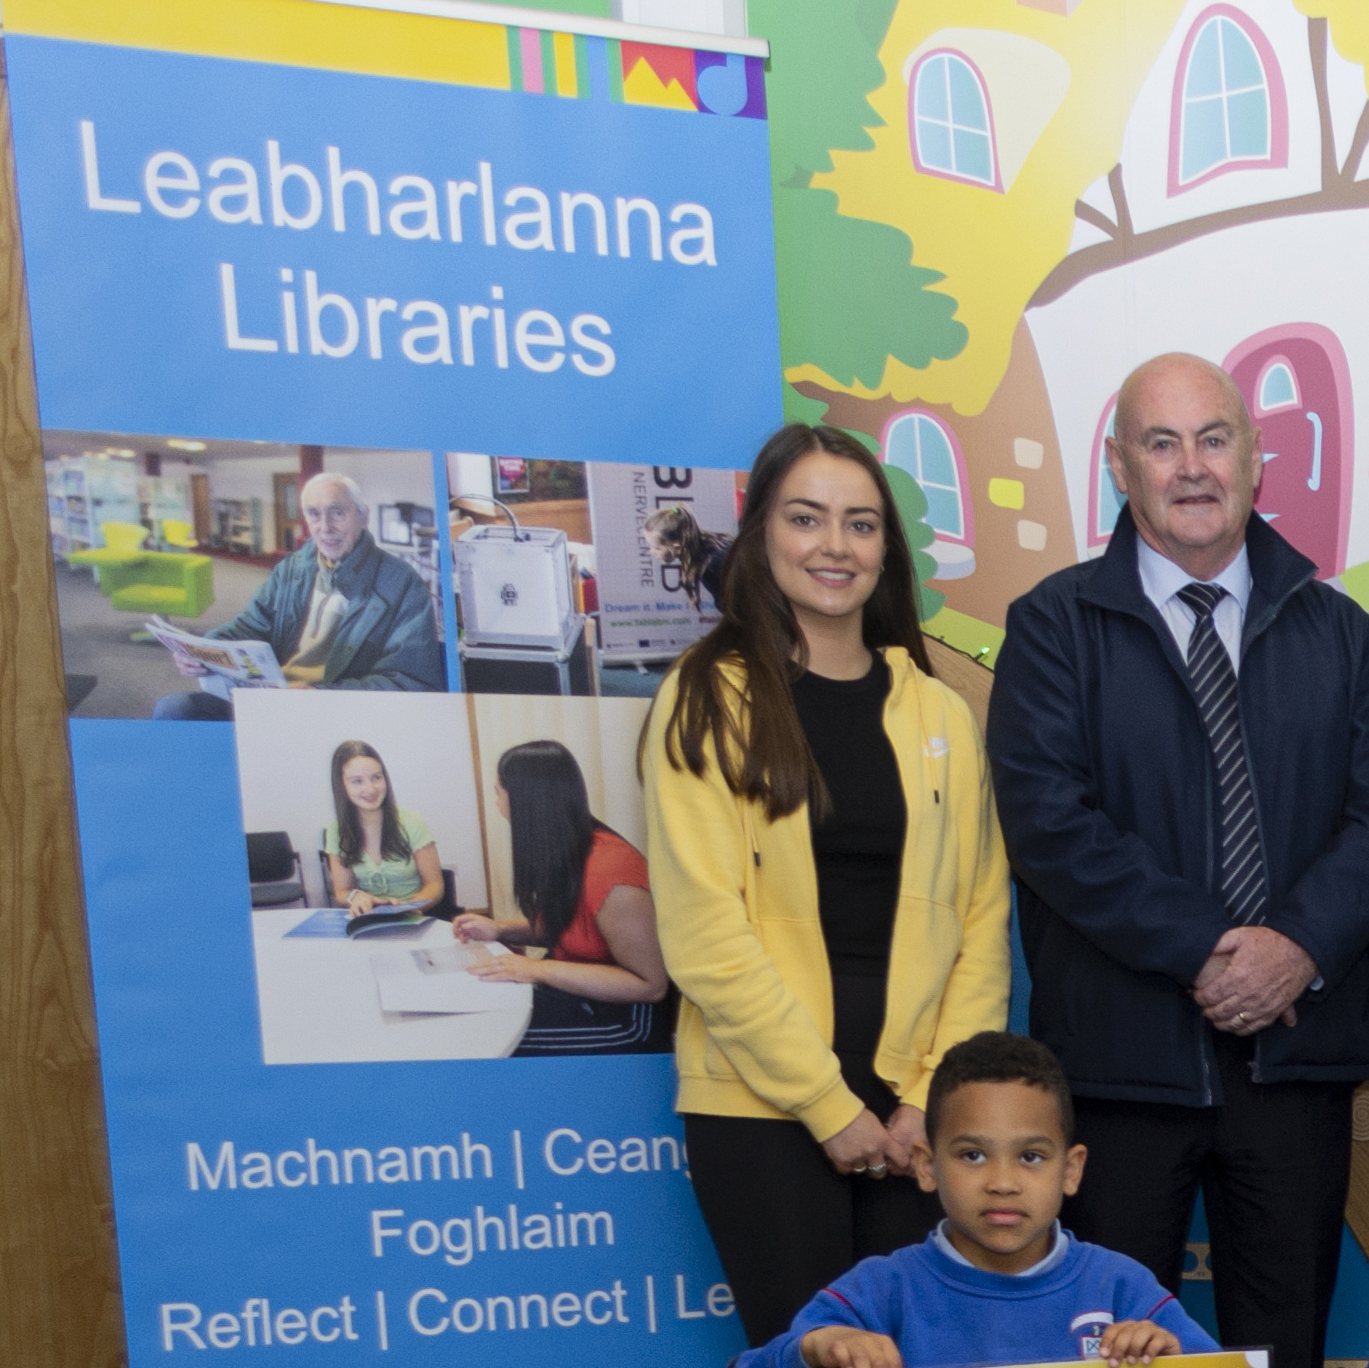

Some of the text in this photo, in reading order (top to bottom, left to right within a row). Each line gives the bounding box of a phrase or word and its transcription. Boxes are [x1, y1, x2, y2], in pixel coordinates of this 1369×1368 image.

[79, 119, 719, 268] Leabharlanna
[219, 261, 618, 378] Libraries
[186, 1133, 494, 1191] Machnamh
[544, 1125, 691, 1177] Cean
[369, 1202, 616, 1267] Foghlaim
[158, 1294, 358, 1352] Reflect
[408, 1277, 630, 1337] Connect
